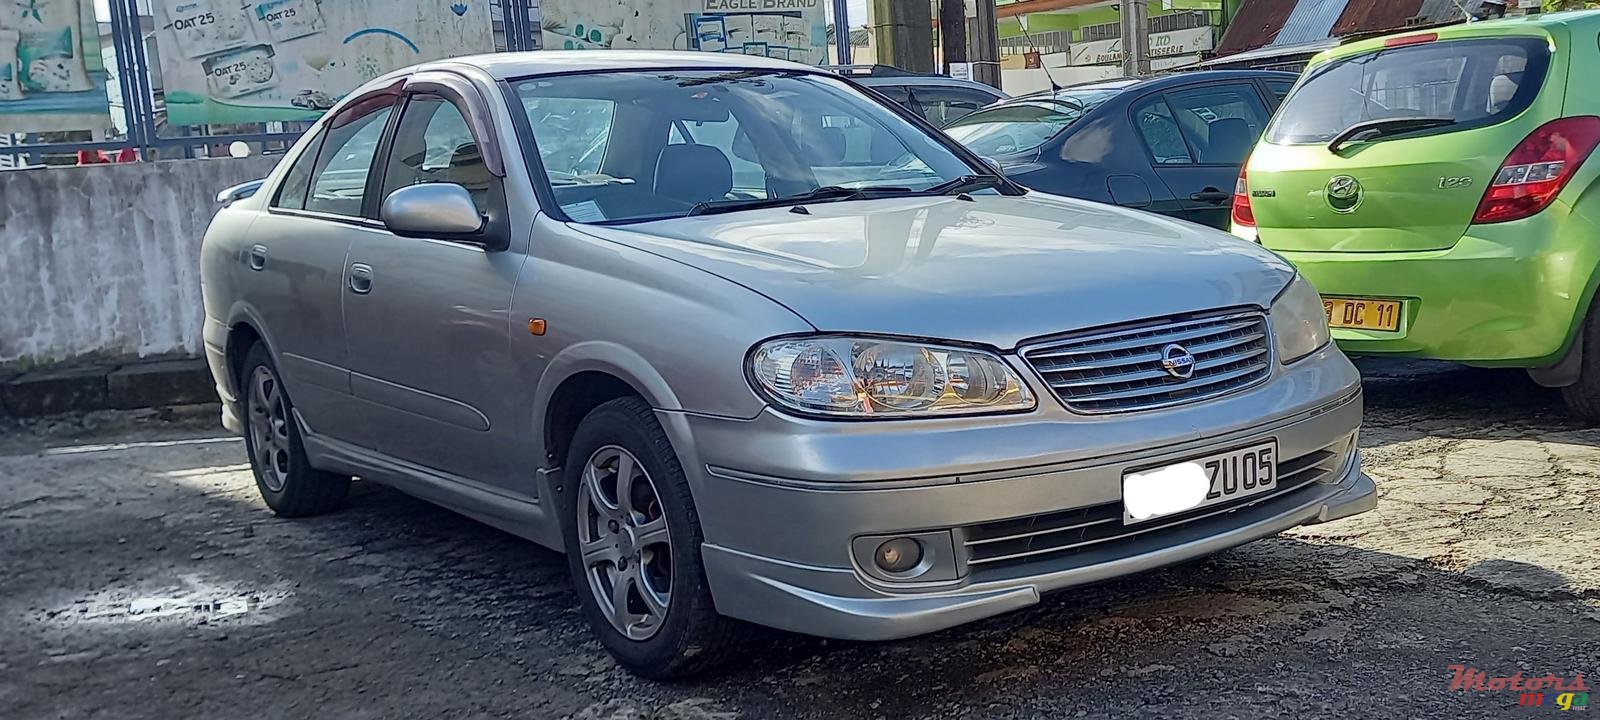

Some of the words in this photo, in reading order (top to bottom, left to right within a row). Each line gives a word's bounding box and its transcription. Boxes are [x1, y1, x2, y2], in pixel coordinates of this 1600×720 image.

[706, 0, 757, 9] EAGLE
[763, 0, 816, 8] BRAND
[174, 16, 197, 30] OAT
[199, 13, 215, 25] 25
[266, 11, 283, 22] OAT
[284, 8, 296, 18] 25
[1151, 45, 1184, 56] TISSERIE
[214, 64, 233, 77] OAT
[233, 61, 247, 72] 25
[1343, 302, 1365, 324] DC
[1377, 304, 1393, 326] 11
